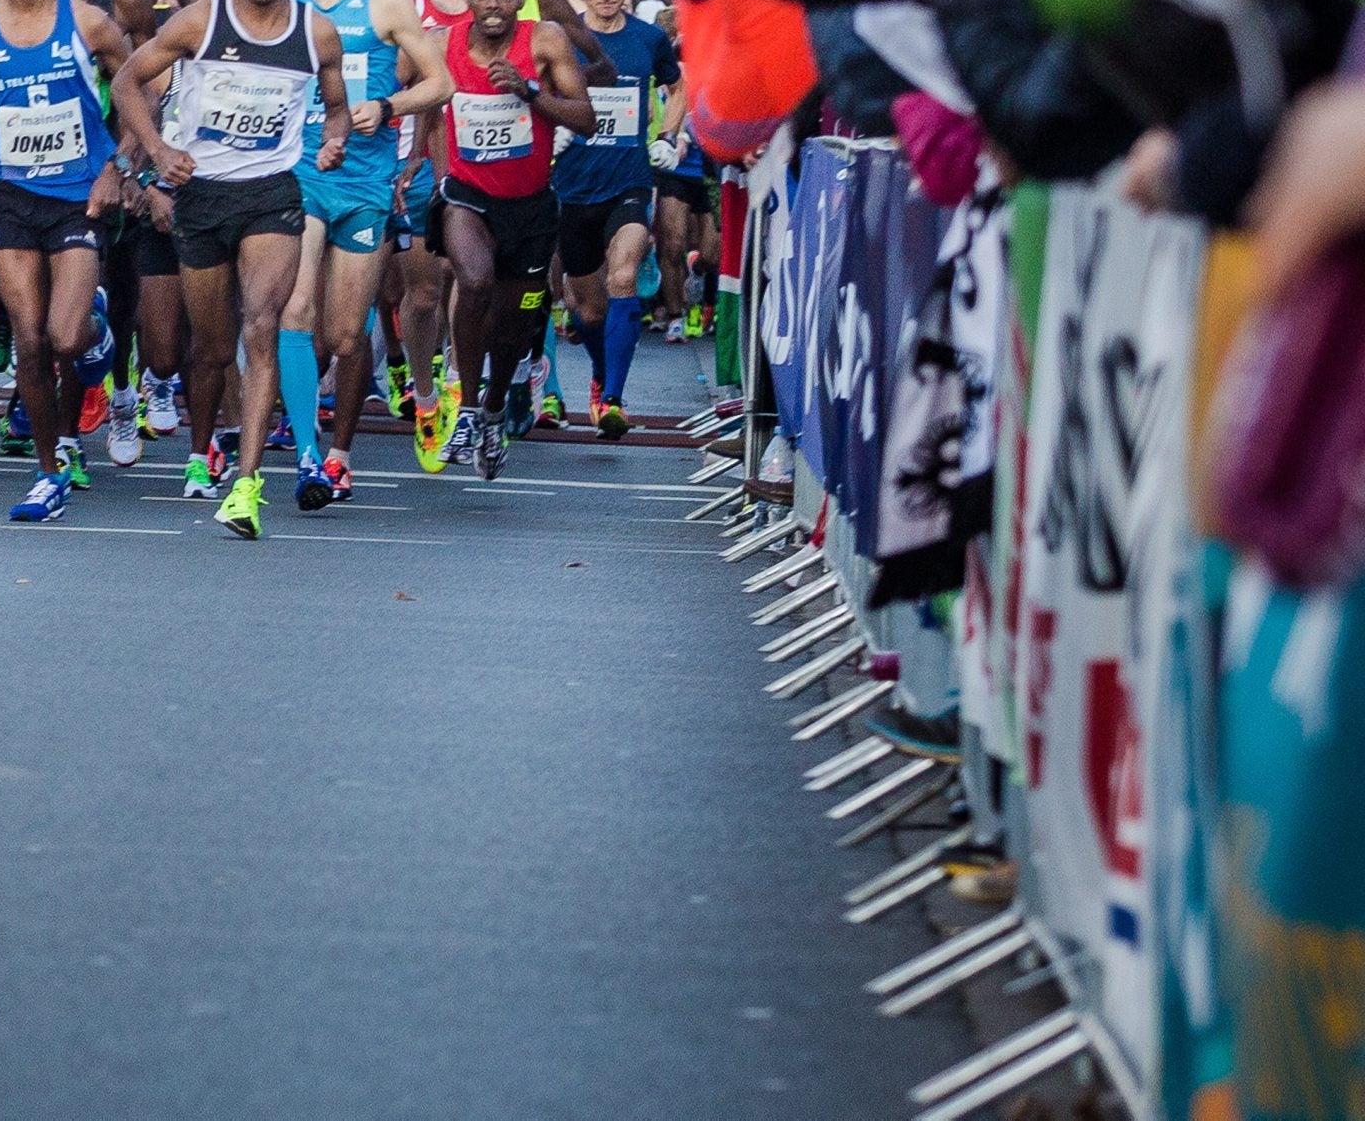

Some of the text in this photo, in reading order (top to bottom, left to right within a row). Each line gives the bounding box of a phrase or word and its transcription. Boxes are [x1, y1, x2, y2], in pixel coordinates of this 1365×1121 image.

[229, 83, 284, 96] mainova
[210, 110, 277, 135] 11895
[10, 130, 67, 154] JONAS
[473, 127, 512, 147] 625
